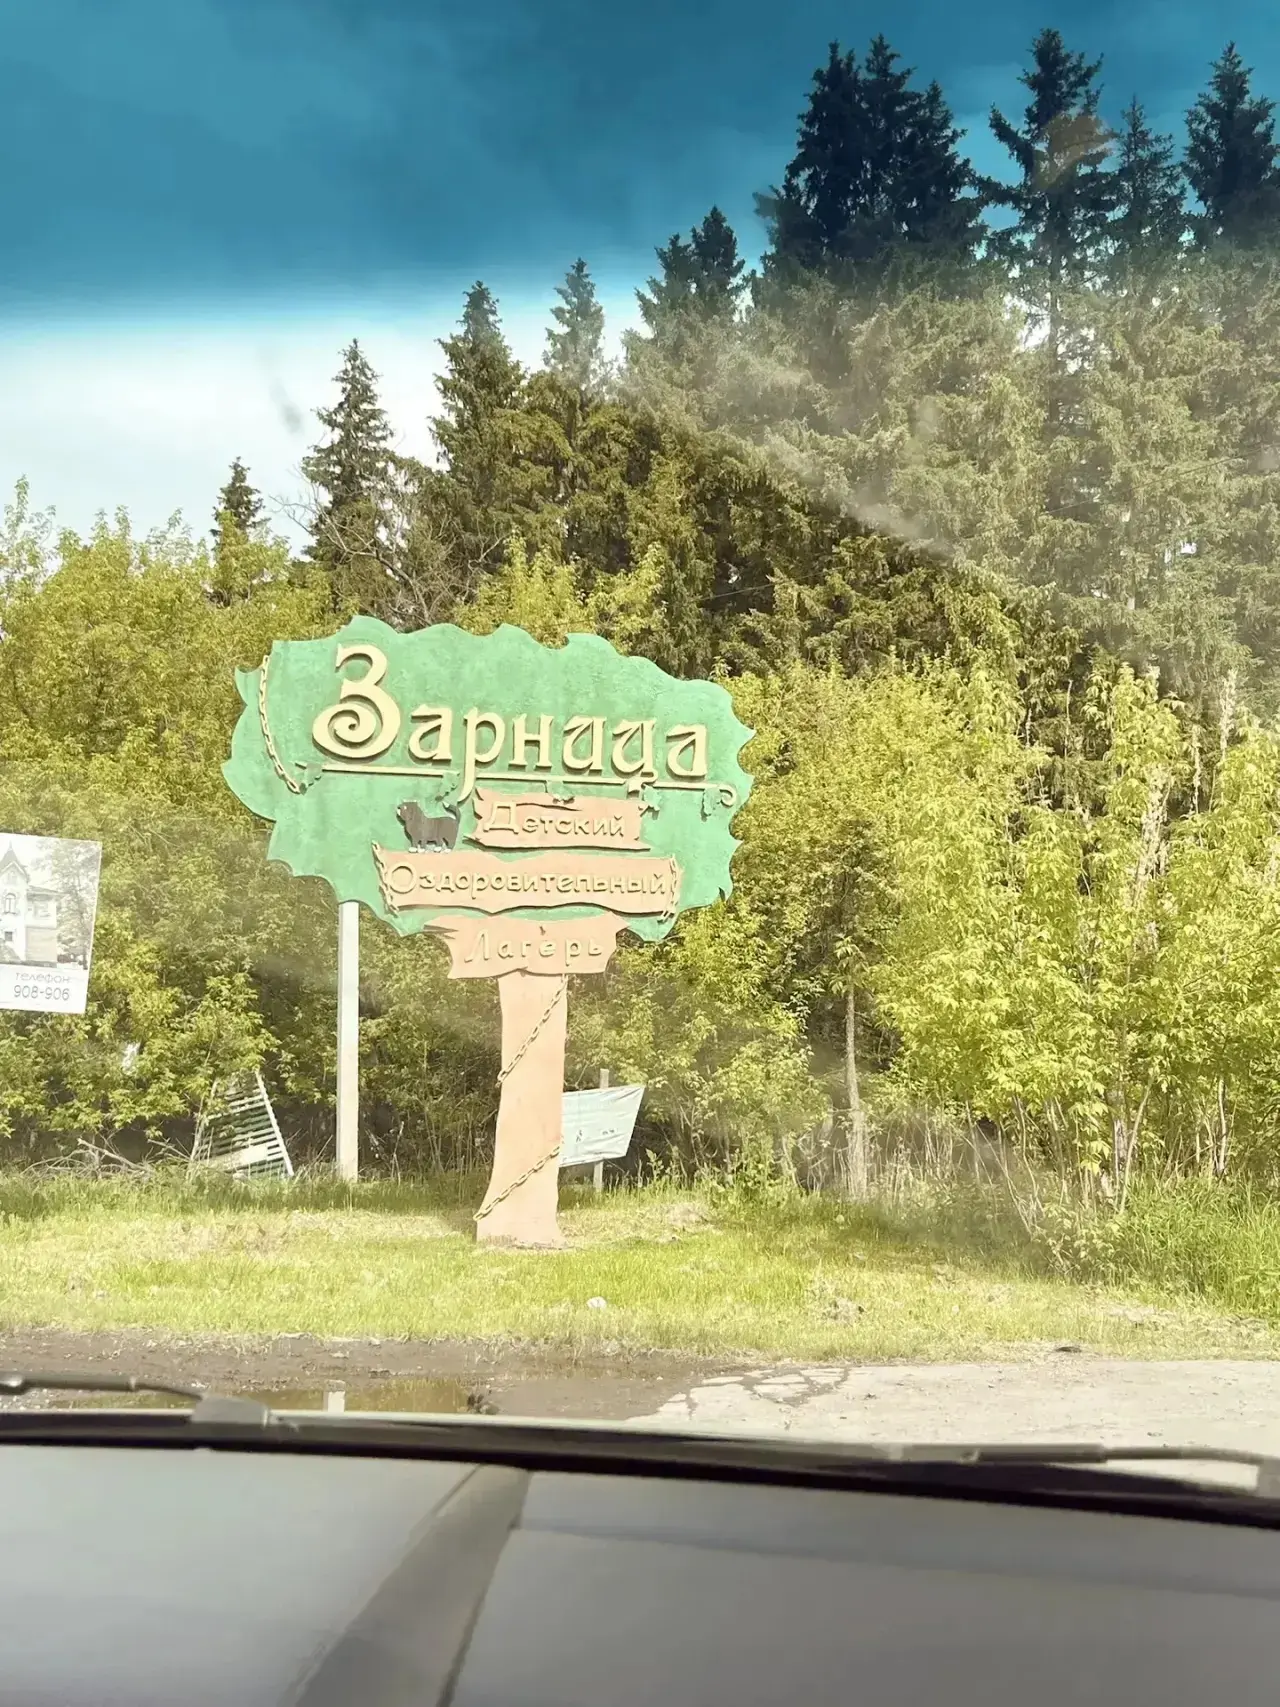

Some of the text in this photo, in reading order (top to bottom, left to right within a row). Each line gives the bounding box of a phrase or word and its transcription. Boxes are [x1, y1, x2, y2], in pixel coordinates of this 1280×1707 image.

[312, 643, 708, 803] Зарница
[482, 802, 626, 838] Детский
[388, 864, 667, 898] Оздоровительный
[464, 931, 603, 966] Лагерь
[14, 985, 70, 1001] 908-906
[15, 972, 70, 984] телефон
